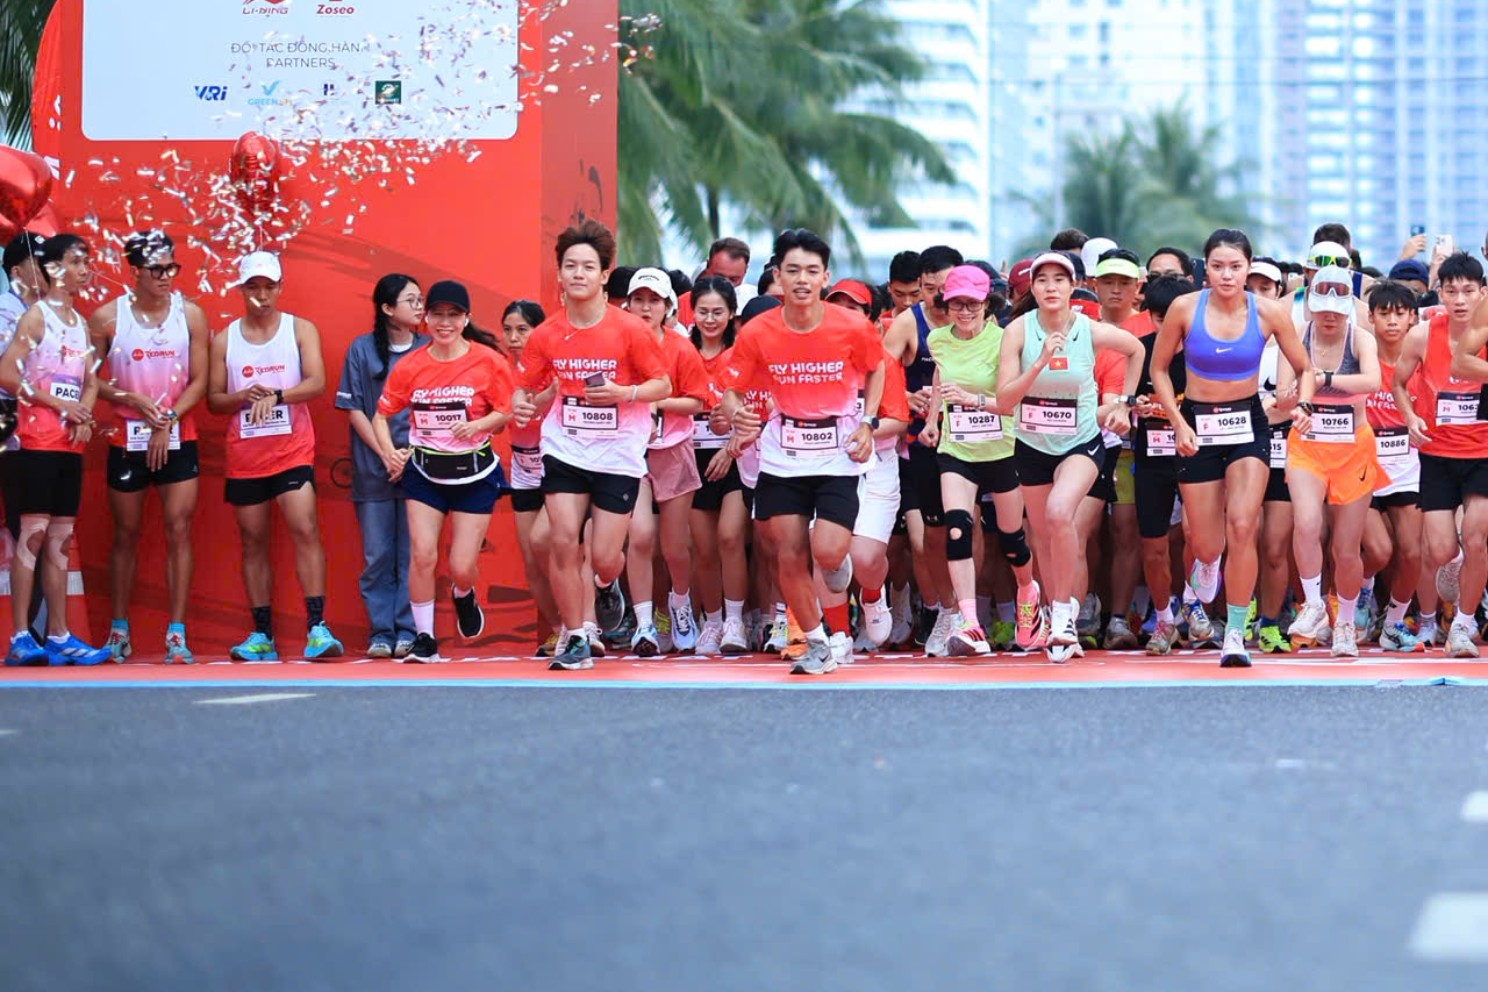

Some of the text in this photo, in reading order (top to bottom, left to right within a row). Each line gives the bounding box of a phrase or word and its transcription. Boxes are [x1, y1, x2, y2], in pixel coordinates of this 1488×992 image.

[569, 359, 617, 370] HIGHER
[791, 361, 844, 374] HIGHER
[798, 373, 843, 384] FASTER
[582, 412, 613, 421] 10808
[1042, 410, 1072, 419] 10670
[968, 415, 995, 424] 10287
[1217, 416, 1247, 427] 10628
[1322, 417, 1349, 426] 10766
[801, 432, 833, 441] 10802
[1380, 439, 1406, 449] 10886
